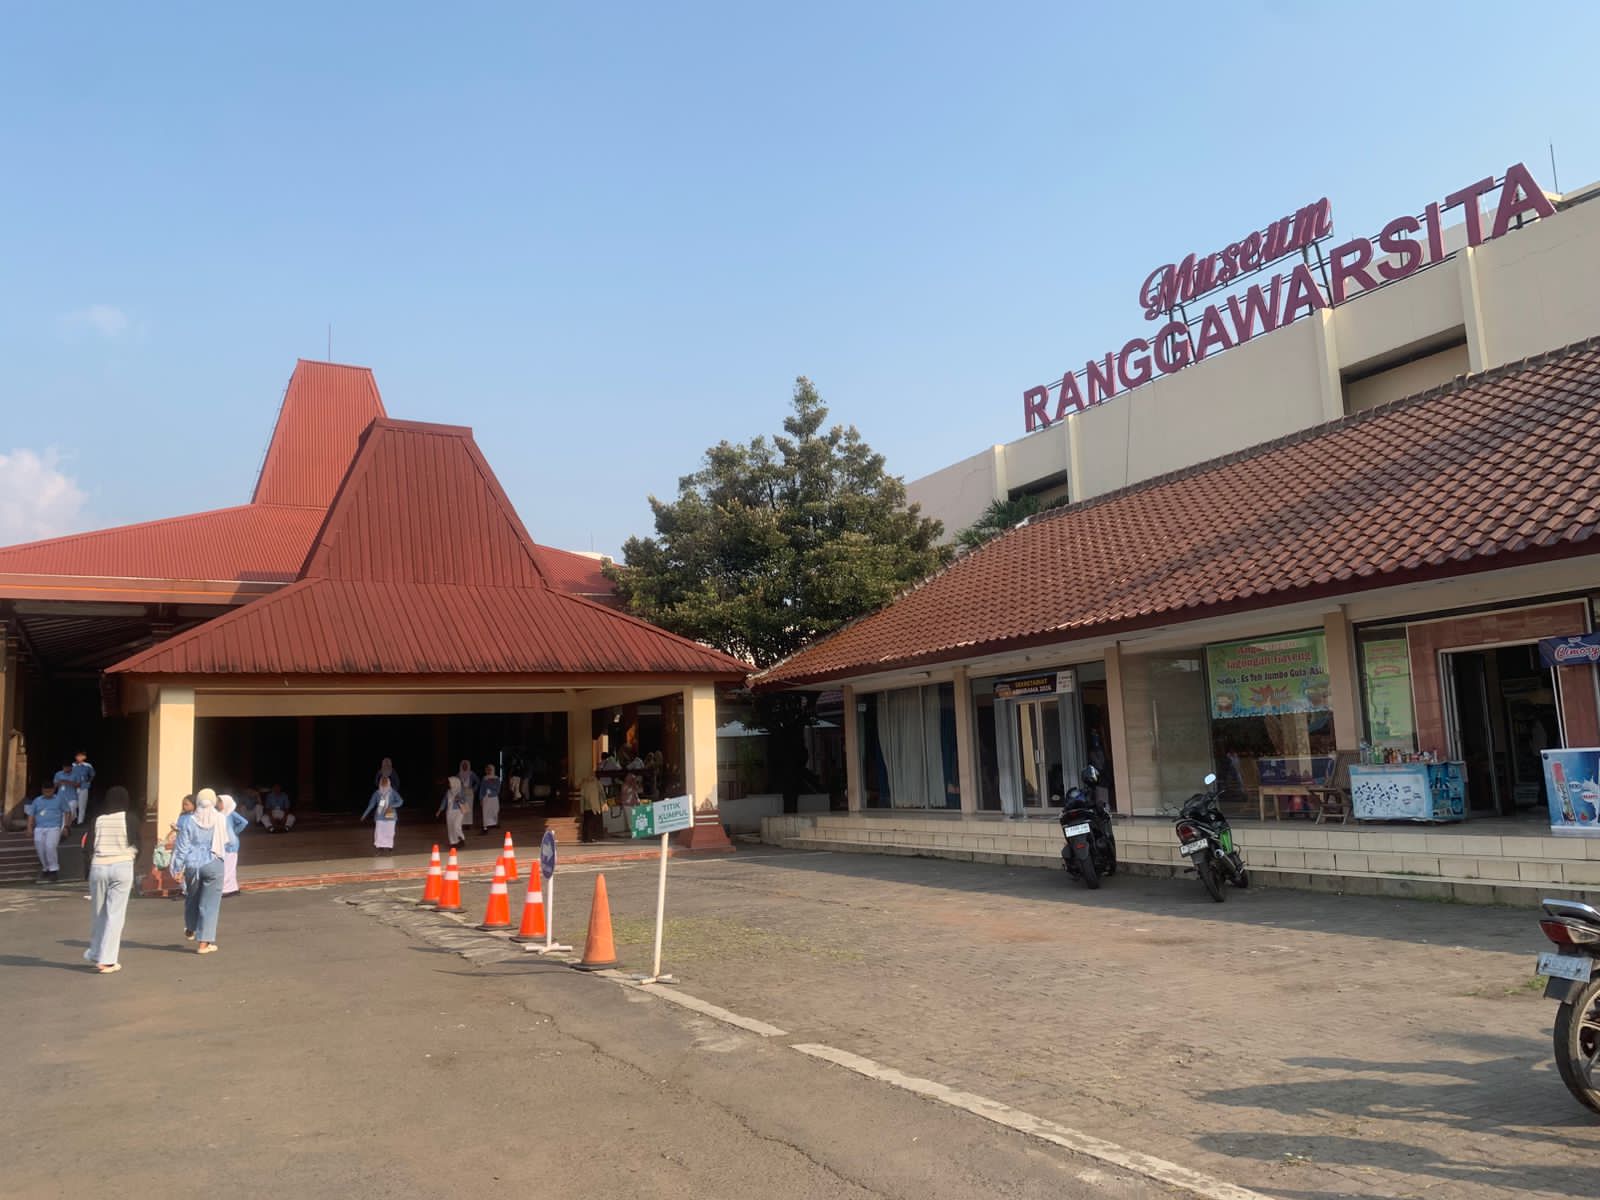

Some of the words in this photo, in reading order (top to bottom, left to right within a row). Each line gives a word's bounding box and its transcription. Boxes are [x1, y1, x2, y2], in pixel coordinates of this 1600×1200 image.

[1139, 197, 1333, 320] Museum
[1024, 162, 1556, 433] RANGGAWARSITA
[1241, 674, 1249, 683] Es
[1264, 671, 1288, 681] Jumbo
[662, 802, 681, 812] TITIK
